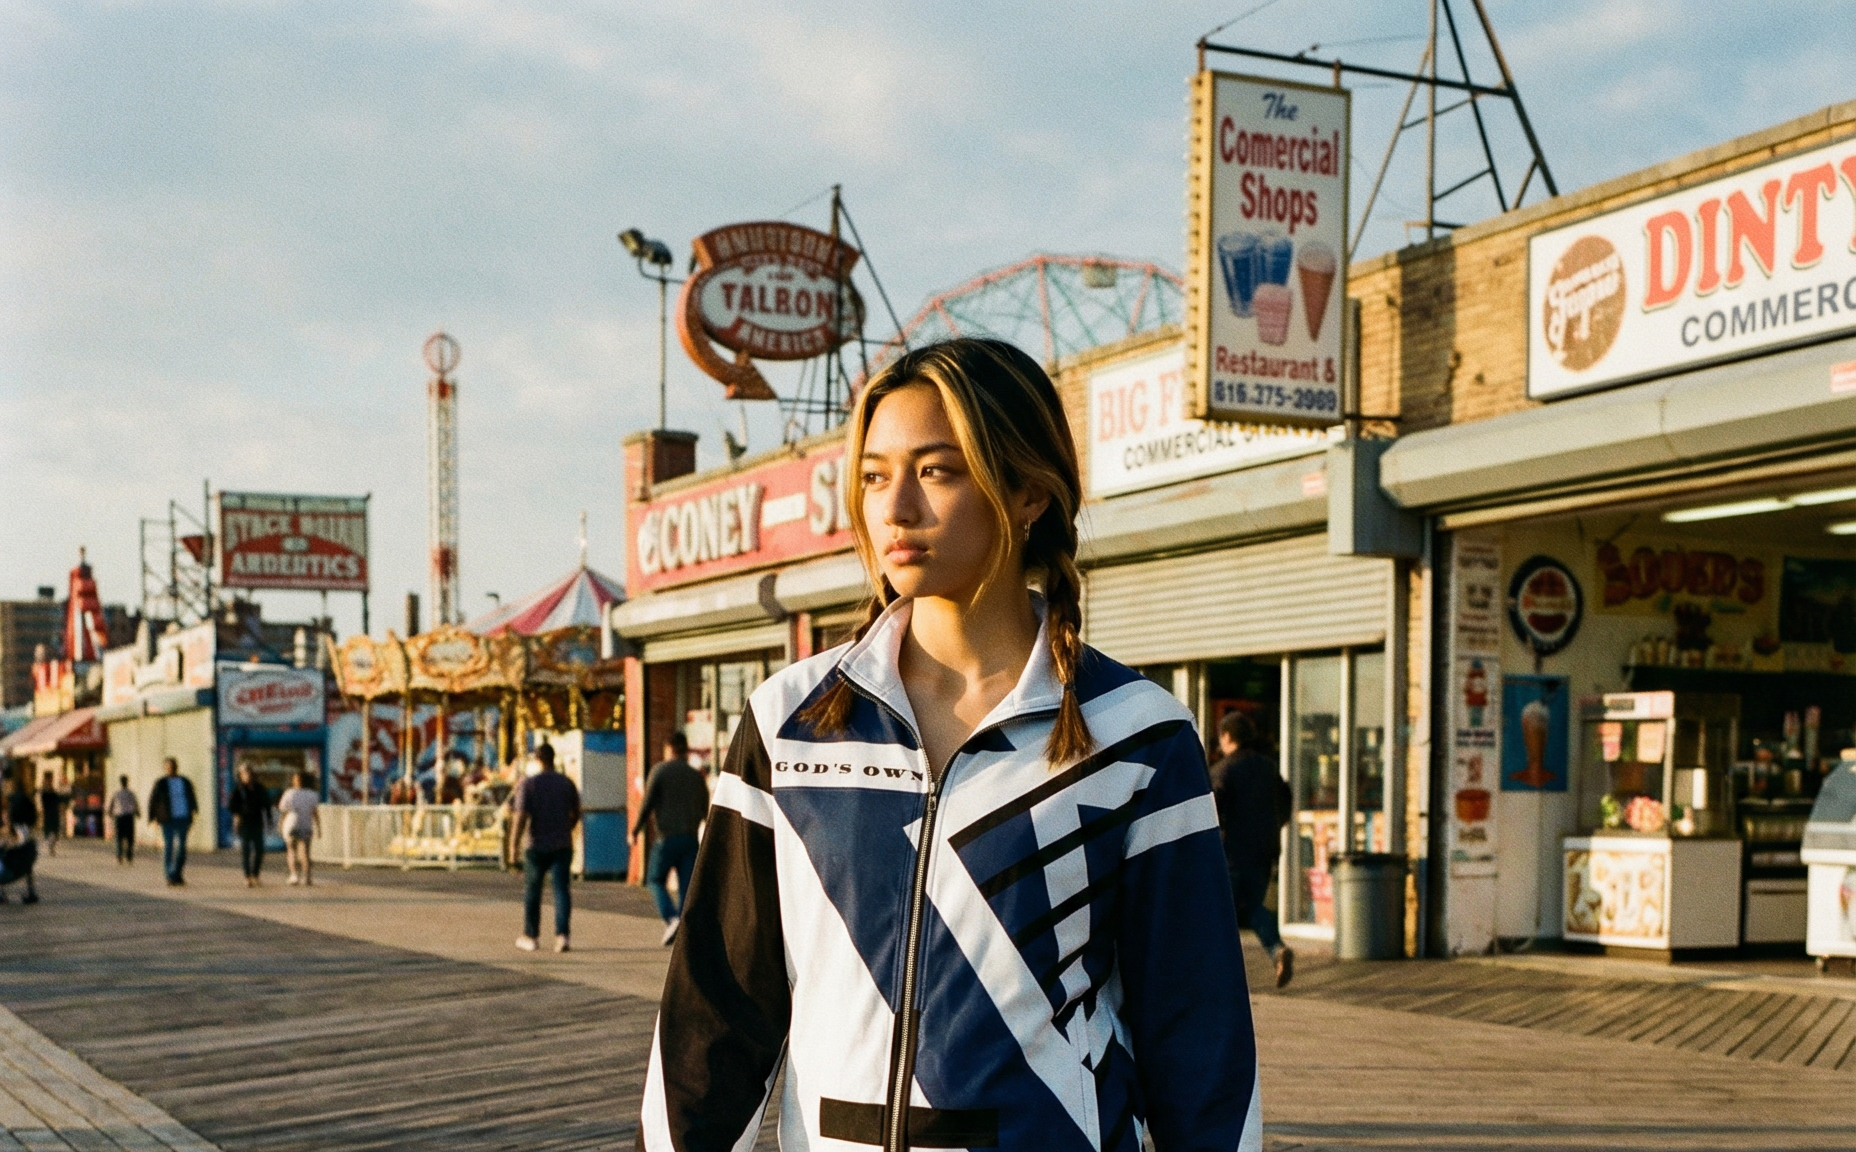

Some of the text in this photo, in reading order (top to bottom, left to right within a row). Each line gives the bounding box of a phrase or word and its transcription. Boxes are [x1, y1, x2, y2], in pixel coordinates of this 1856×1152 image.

[1262, 92, 1298, 121] The
[1241, 171, 1318, 235] Shops
[1216, 345, 1318, 382] Restaurant
[1098, 379, 1148, 443] BIG
[775, 761, 924, 782] GOD'S OWN
